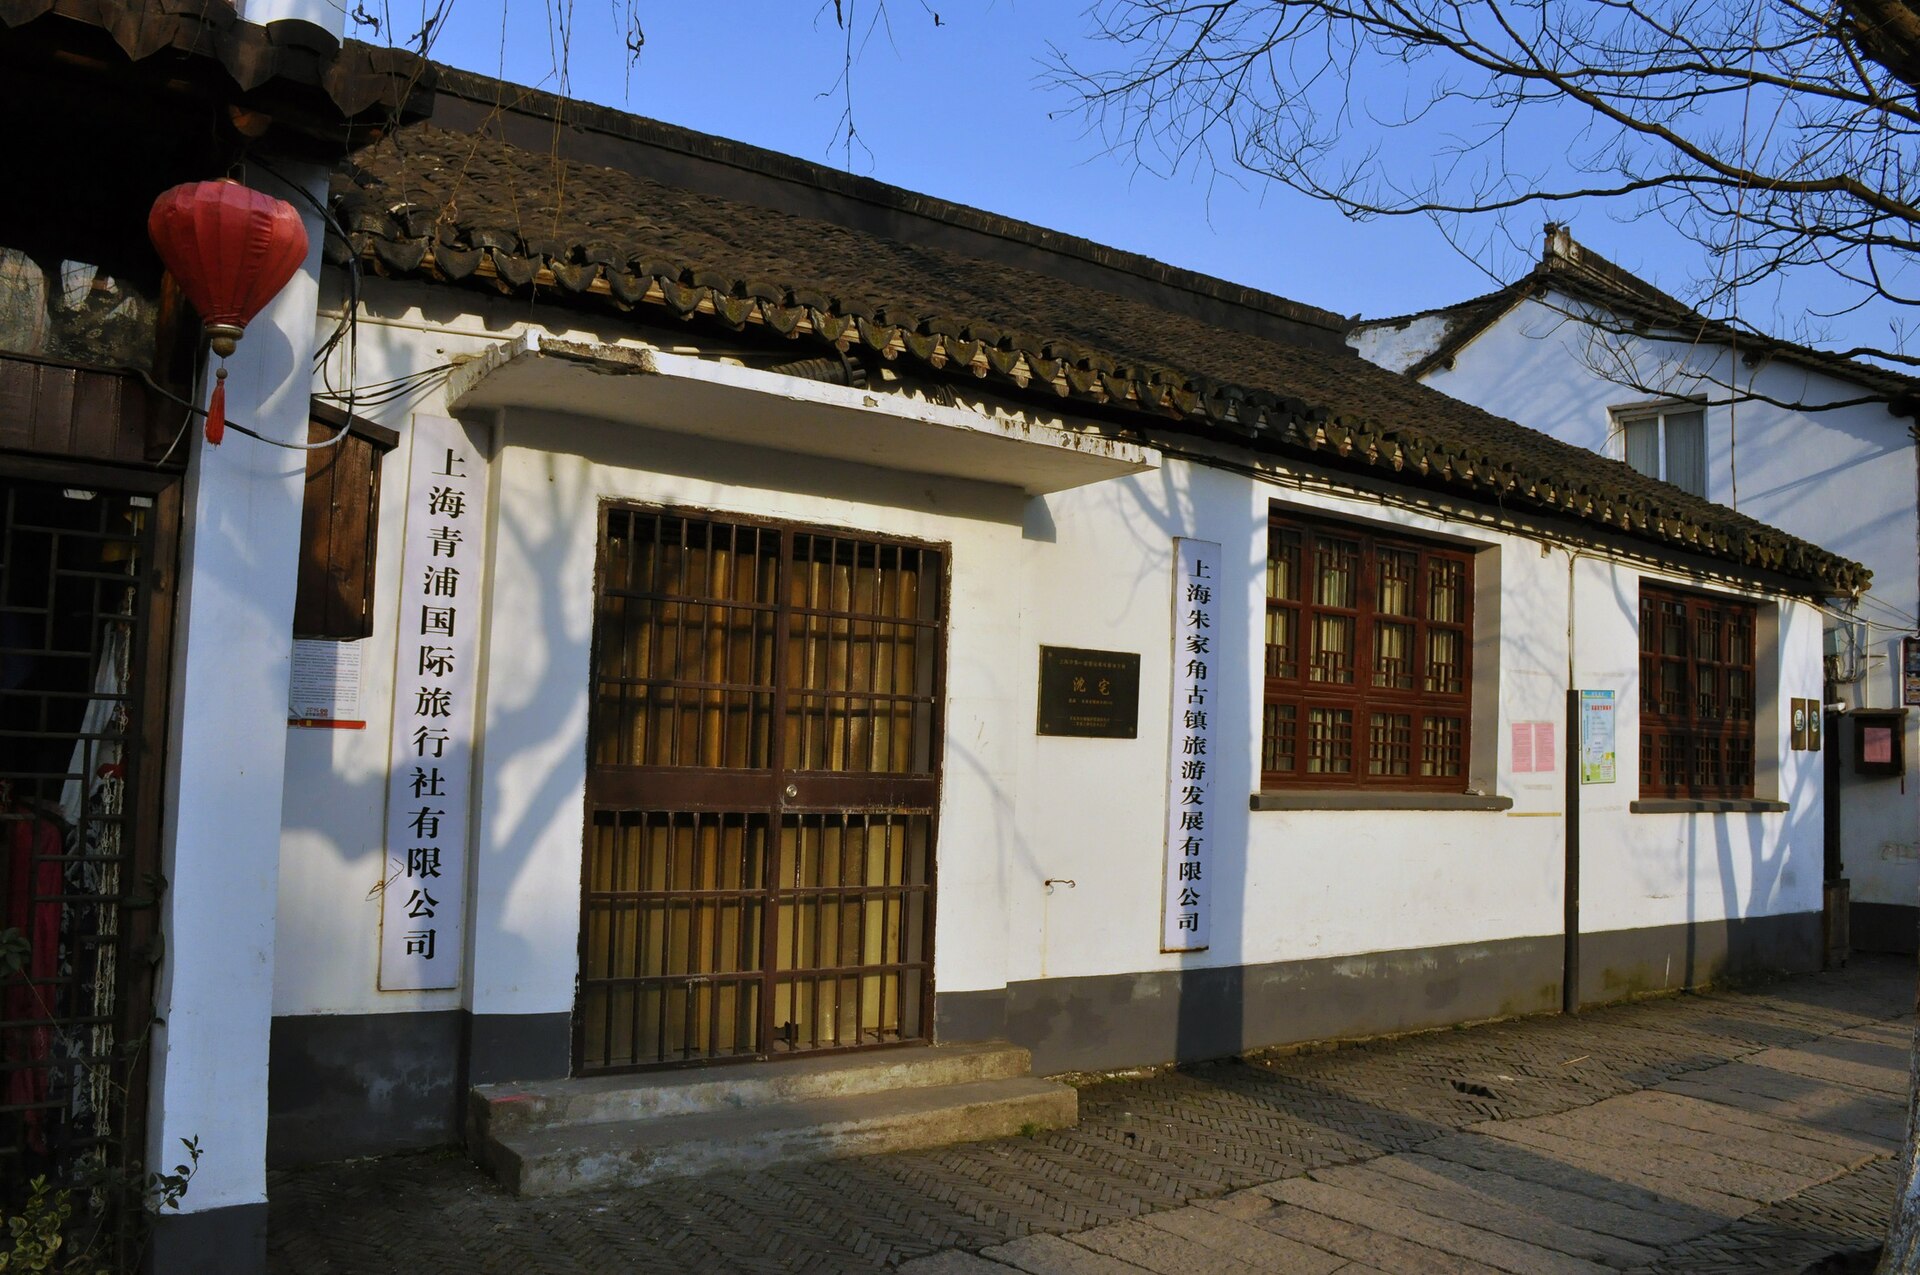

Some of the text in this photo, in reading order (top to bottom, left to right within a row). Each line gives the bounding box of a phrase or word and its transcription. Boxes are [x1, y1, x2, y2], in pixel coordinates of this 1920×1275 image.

[403, 447, 467, 960] 上海青浦国际旅行社有限公司
[1178, 559, 1212, 933] 上海朱家角古镇旅游发展有限公司
